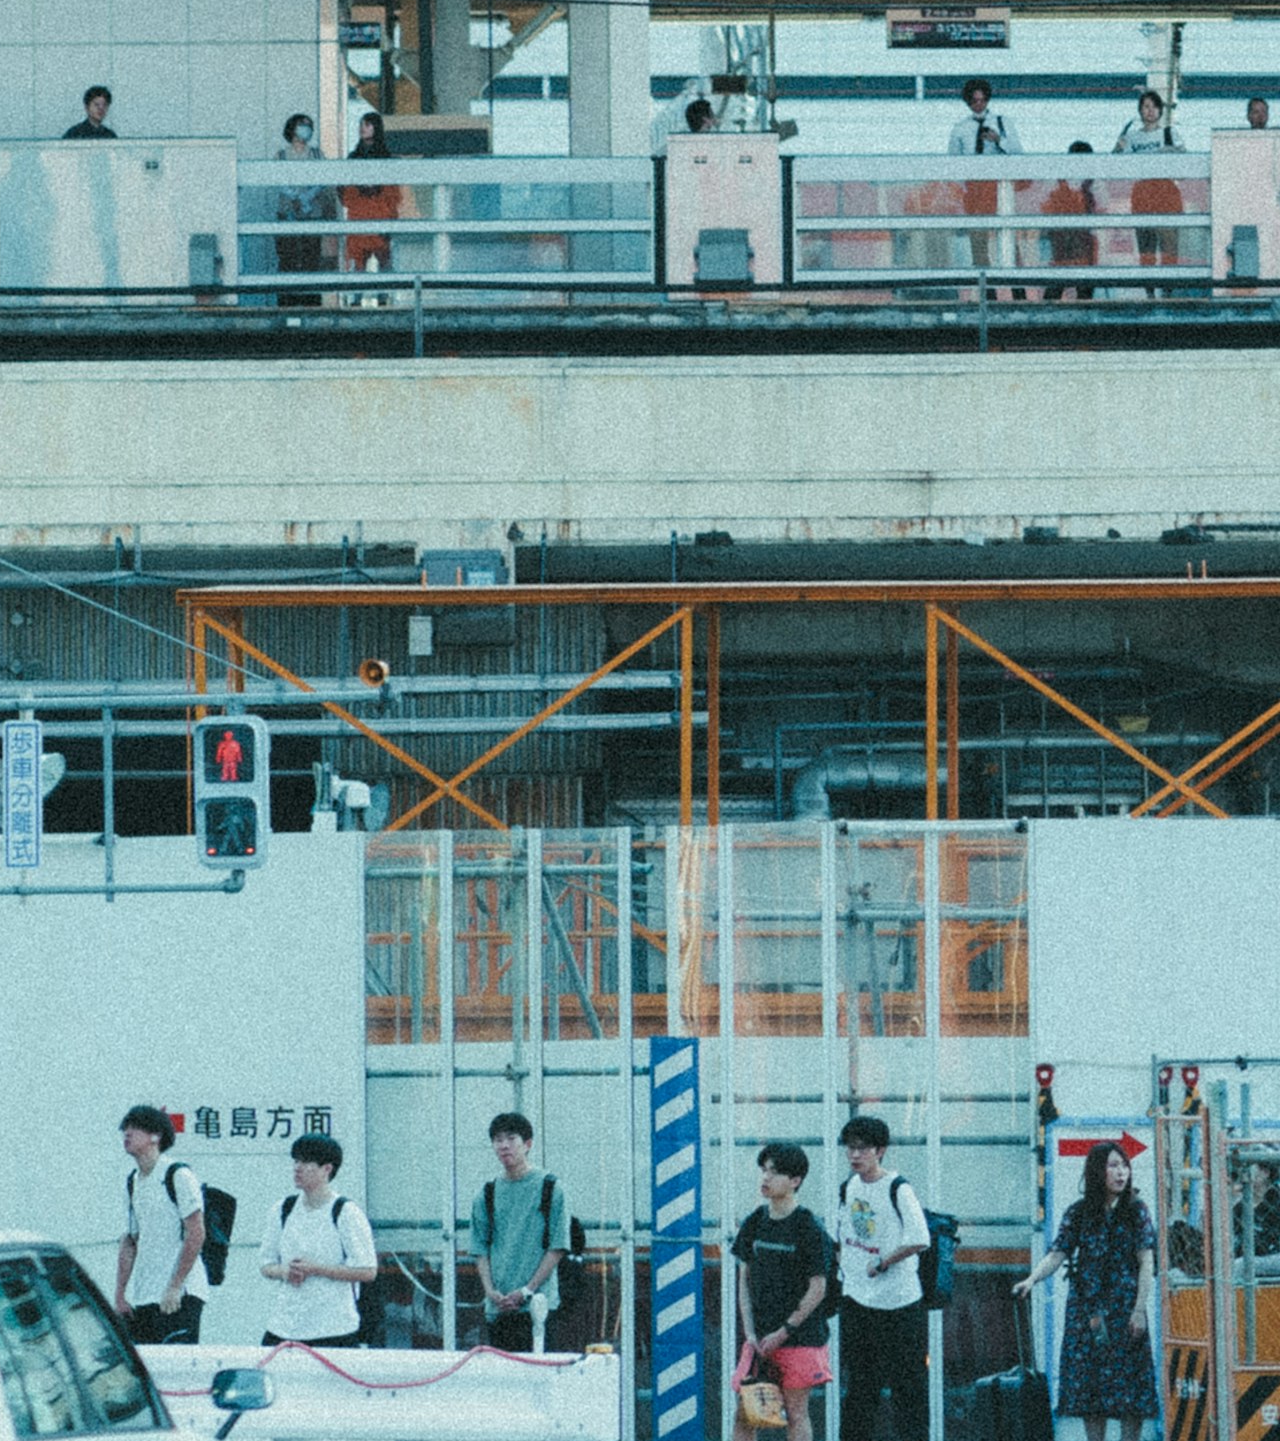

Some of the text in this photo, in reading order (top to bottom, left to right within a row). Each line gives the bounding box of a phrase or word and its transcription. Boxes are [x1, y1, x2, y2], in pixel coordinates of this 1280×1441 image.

[10, 731, 34, 863] 歩車分離式
[194, 1105, 333, 1139] 亀島方面
